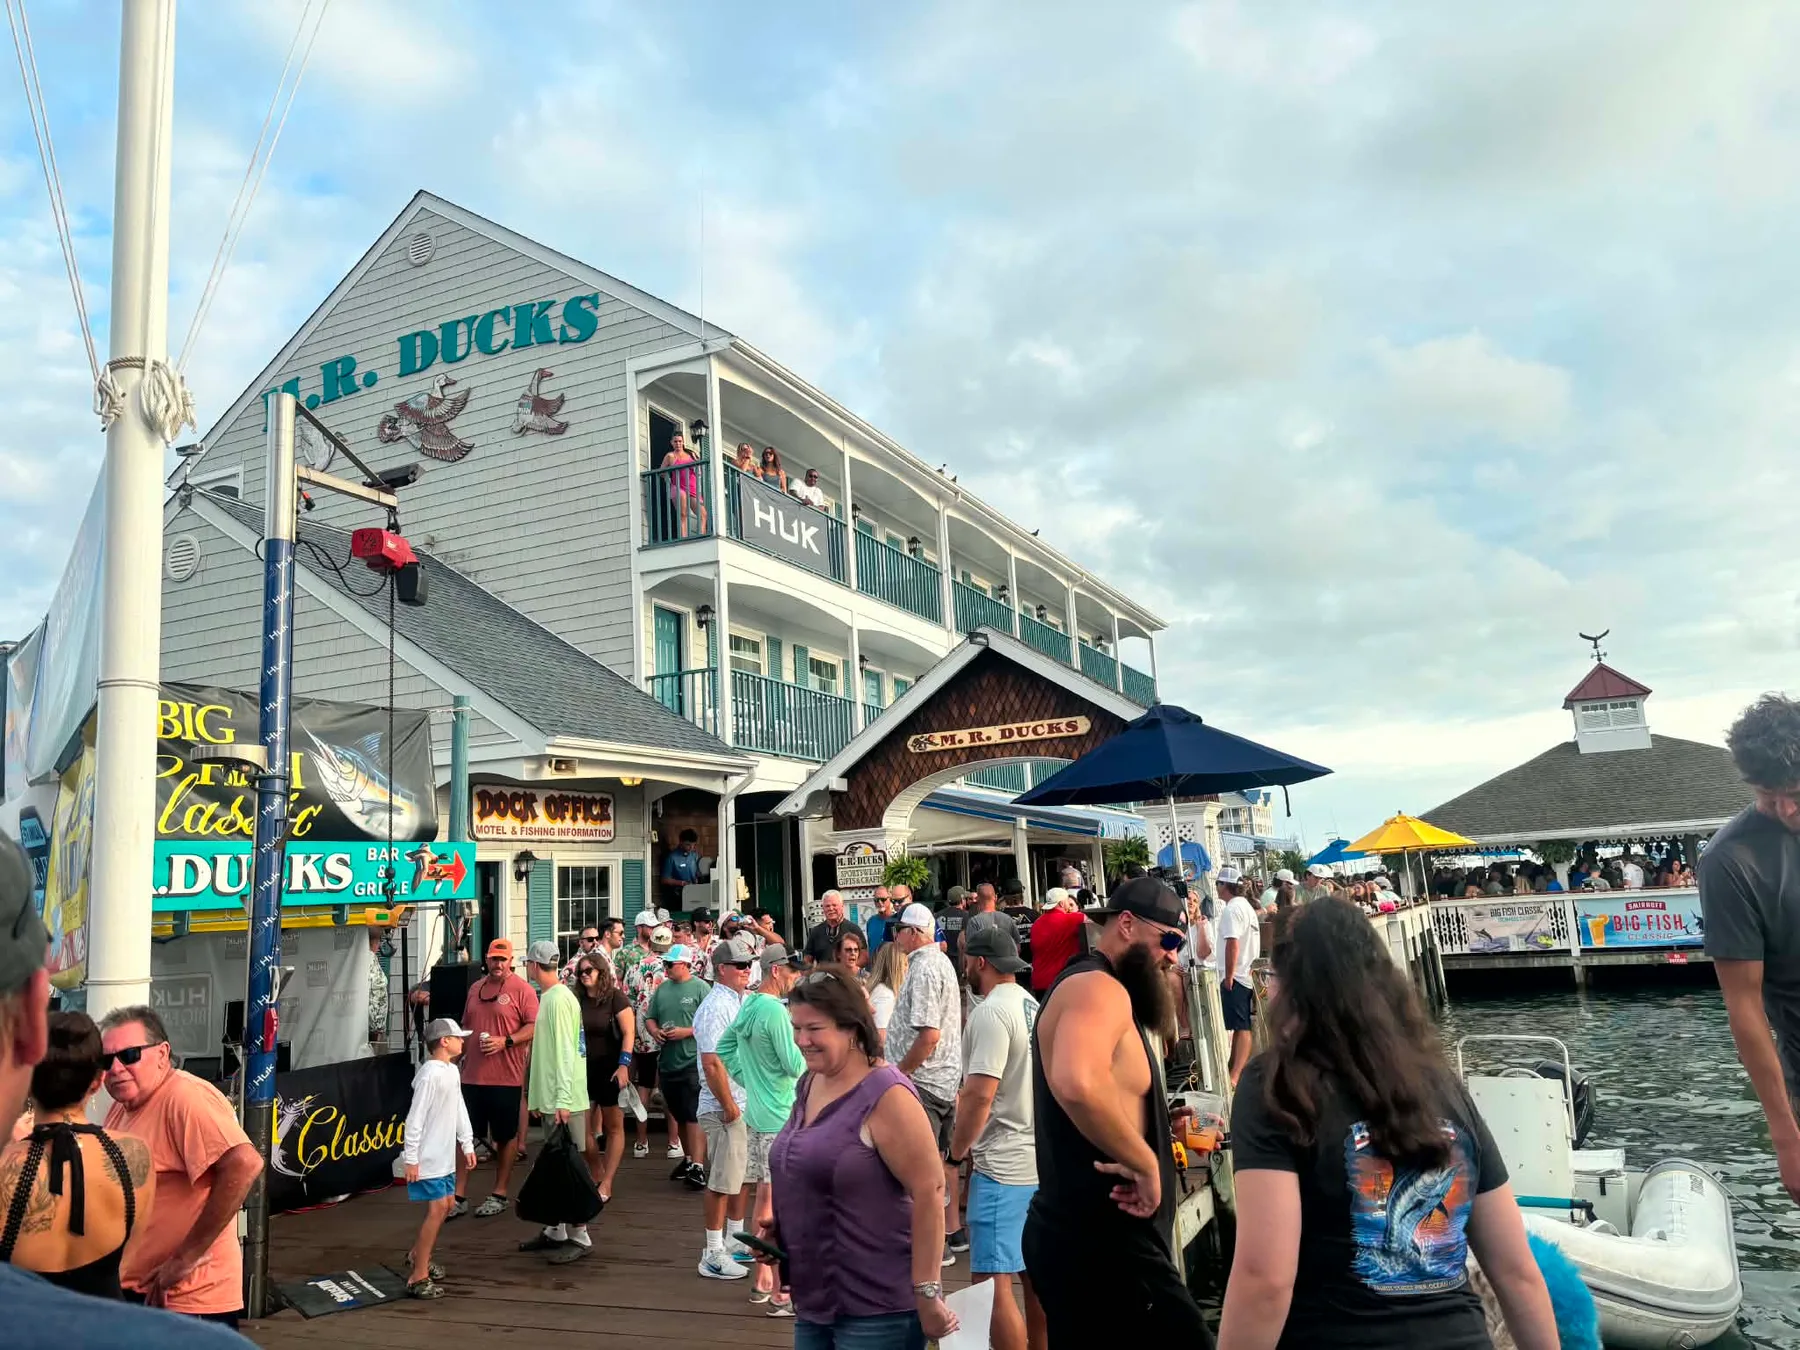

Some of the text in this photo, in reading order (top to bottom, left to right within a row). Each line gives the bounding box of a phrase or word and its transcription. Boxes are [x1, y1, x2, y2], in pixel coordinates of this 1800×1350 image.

[397, 292, 600, 378] DUCKS
[753, 498, 821, 555] HUK
[157, 700, 236, 744] BIG
[940, 719, 1079, 747] M. R. DUCKS
[261, 797, 282, 816] HUK
[475, 789, 612, 825] DOCK OFFICE
[475, 825, 612, 838] MOTEL & FISHING INFORMATION
[260, 835, 281, 854] HUK
[367, 847, 400, 861] BAR
[259, 872, 280, 891] HUK
[1613, 913, 1683, 932] BIG FISH
[1628, 932, 1674, 940] CLASSIC
[254, 1063, 274, 1087] HUK
